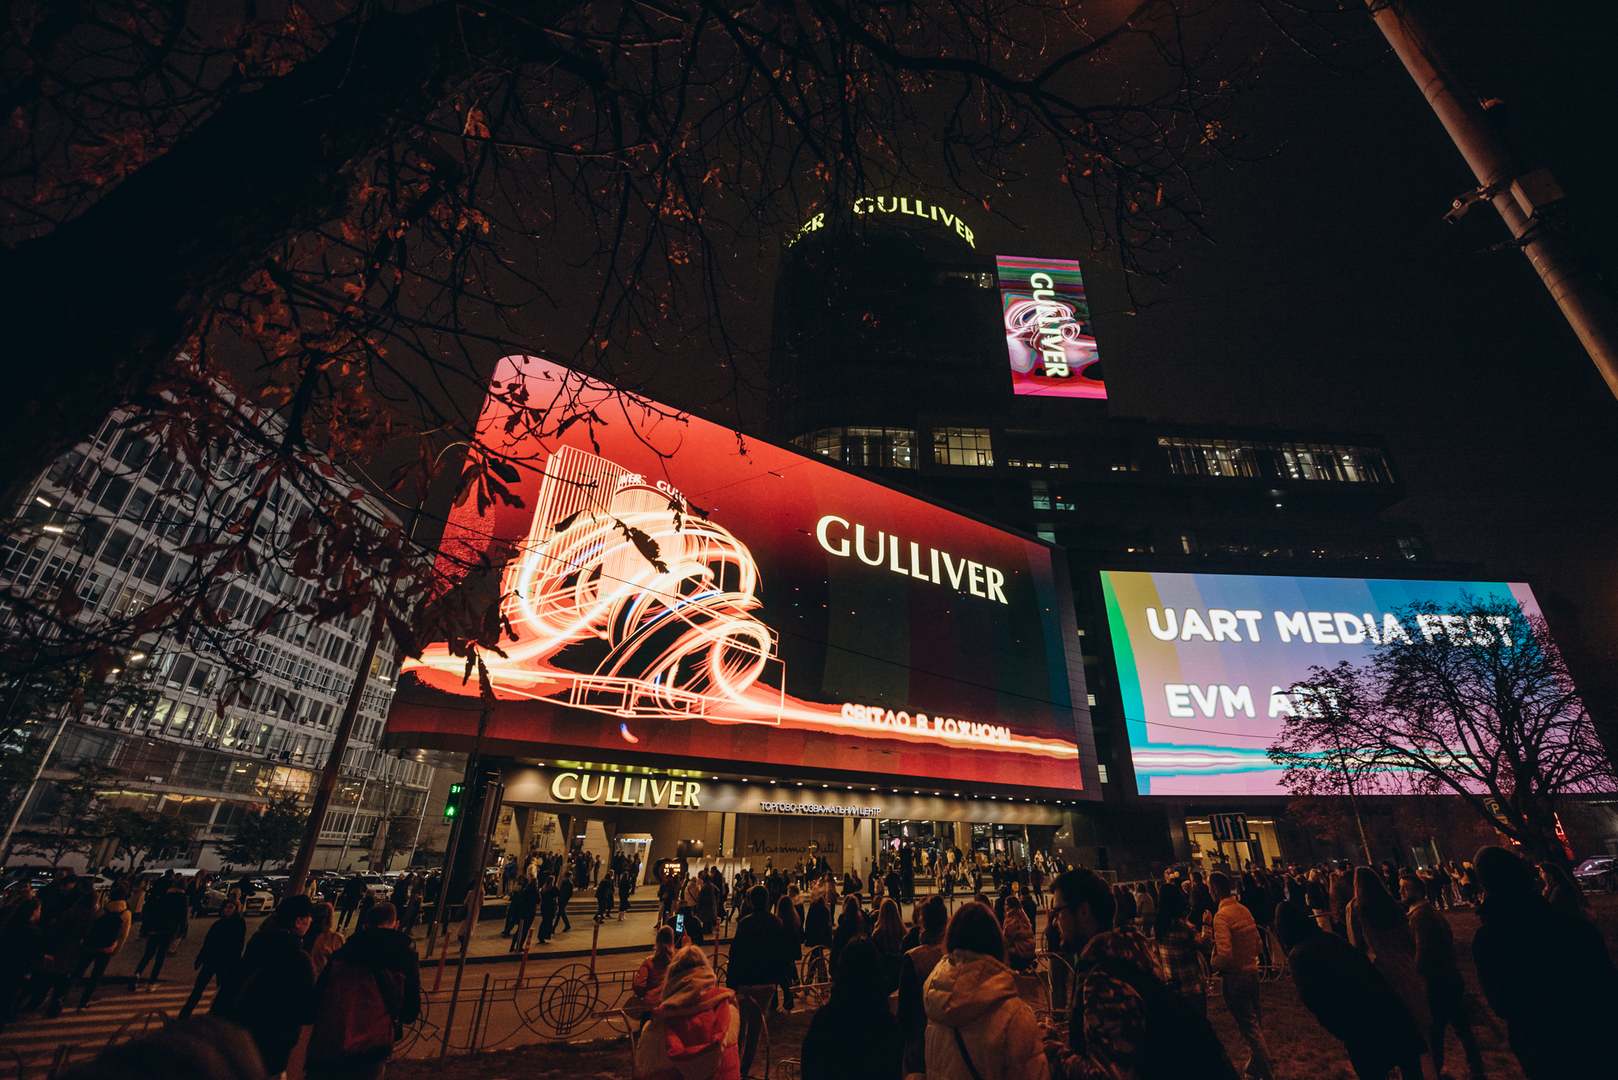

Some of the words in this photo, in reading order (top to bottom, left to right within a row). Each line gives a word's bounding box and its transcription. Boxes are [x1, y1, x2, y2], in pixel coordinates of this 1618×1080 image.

[852, 196, 975, 249] GULLIVER
[1030, 272, 1069, 377] GULLIVER
[816, 515, 1009, 605] GULLIVER
[1145, 607, 1262, 642] UART
[1274, 610, 1414, 645] MEDIA
[1416, 613, 1513, 648] FEST
[1164, 683, 1257, 719] EVM
[1267, 684, 1342, 719] ART
[916, 714, 928, 731] В
[451, 785, 461, 793] 31
[551, 772, 701, 807] GULLIVER
[760, 801, 859, 816] ТОРГОВО-РОЗВАЖАЛЬНИЙ
[859, 806, 882, 816] ЦЕНТР
[1491, 803, 1500, 814] P
[752, 839, 806, 854] Massimo
[808, 839, 840, 854] Dutti
